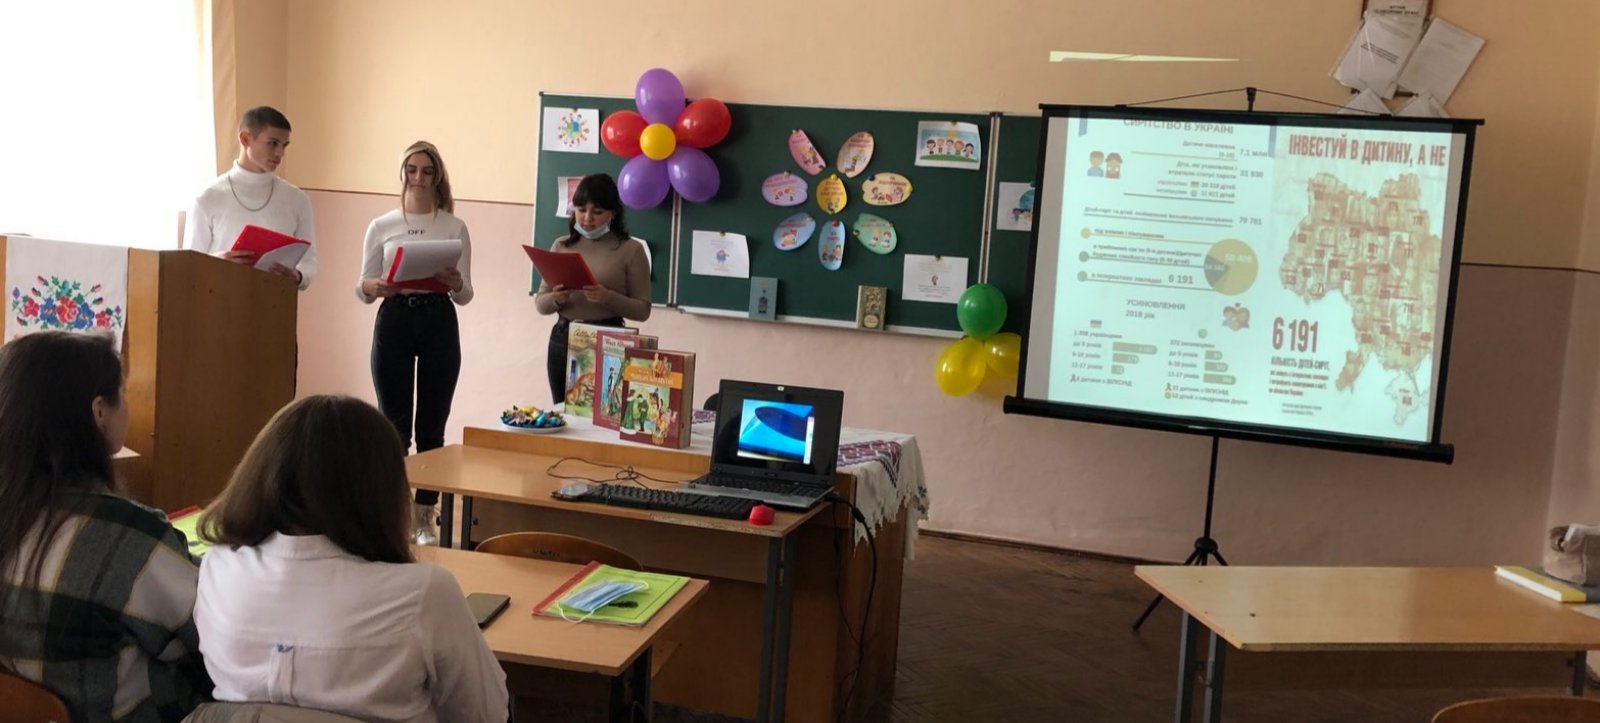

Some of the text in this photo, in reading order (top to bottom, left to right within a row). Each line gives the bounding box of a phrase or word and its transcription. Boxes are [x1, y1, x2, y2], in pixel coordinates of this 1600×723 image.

[1123, 118, 1181, 130] СИРІТСТВО
[1184, 122, 1192, 131] В
[1288, 134, 1447, 167] ІНВЕСТУЙ В ДИТИНУ, А НЕ
[1168, 274, 1174, 283] 6
[1177, 275, 1194, 284] 191
[1126, 299, 1186, 311] УСИНОВЛЕННЯ
[1125, 309, 1143, 319] 2018
[1272, 317, 1319, 353] 6 191
